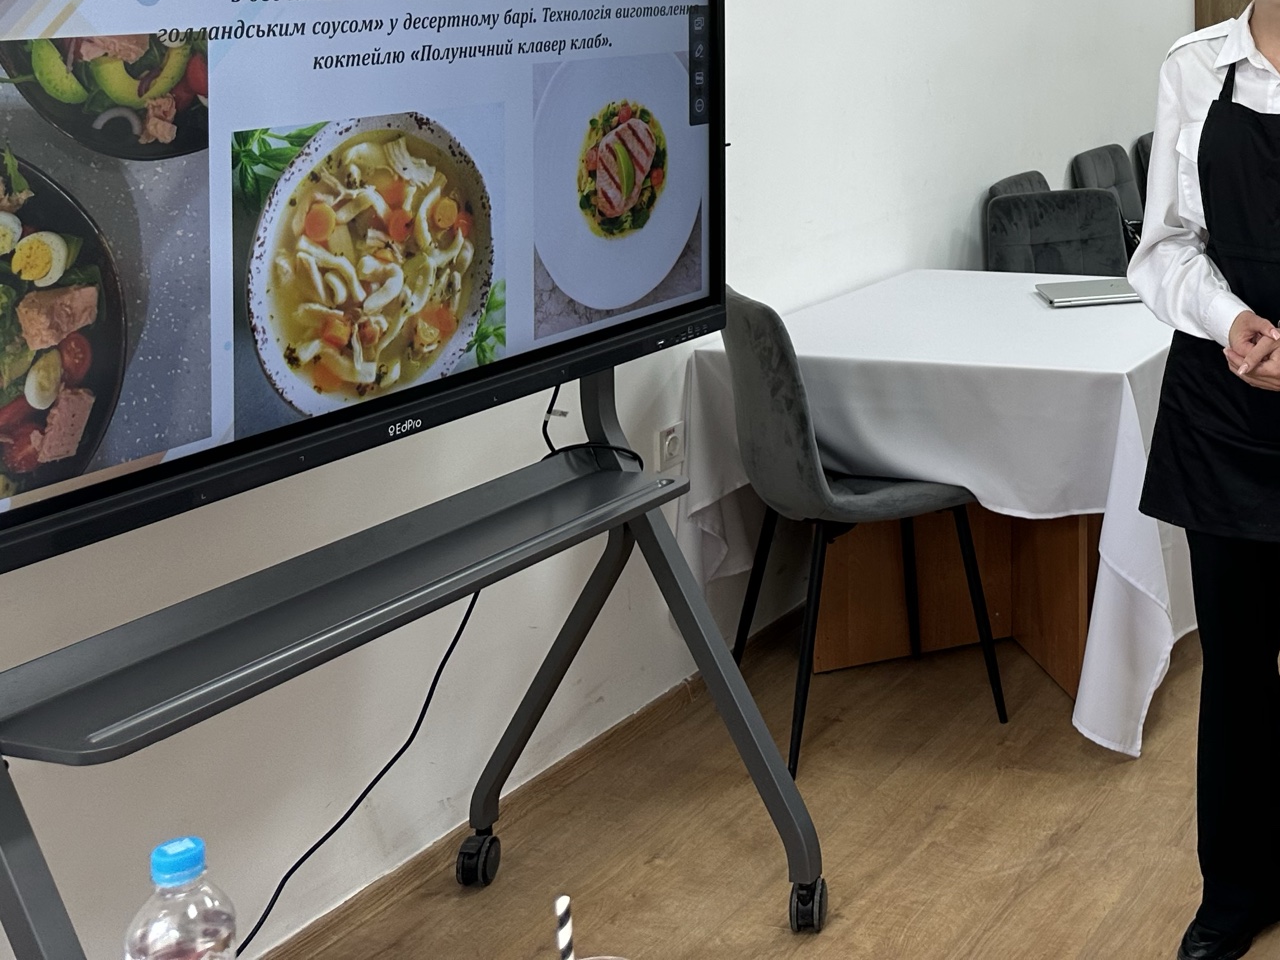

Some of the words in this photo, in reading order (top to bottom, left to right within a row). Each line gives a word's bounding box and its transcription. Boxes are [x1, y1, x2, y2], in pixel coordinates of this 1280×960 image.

[157, 19, 306, 44] голландським
[311, 19, 384, 39] соусом»
[389, 16, 399, 36] у
[403, 11, 500, 32] десертному
[503, 7, 537, 29] барі.
[542, 4, 612, 23] Технологія
[312, 46, 405, 70] коктейлю
[409, 38, 513, 64] «Полуничний
[517, 36, 566, 55] клавер
[570, 33, 613, 50] клаб».
[395, 419, 422, 435] EdPro
